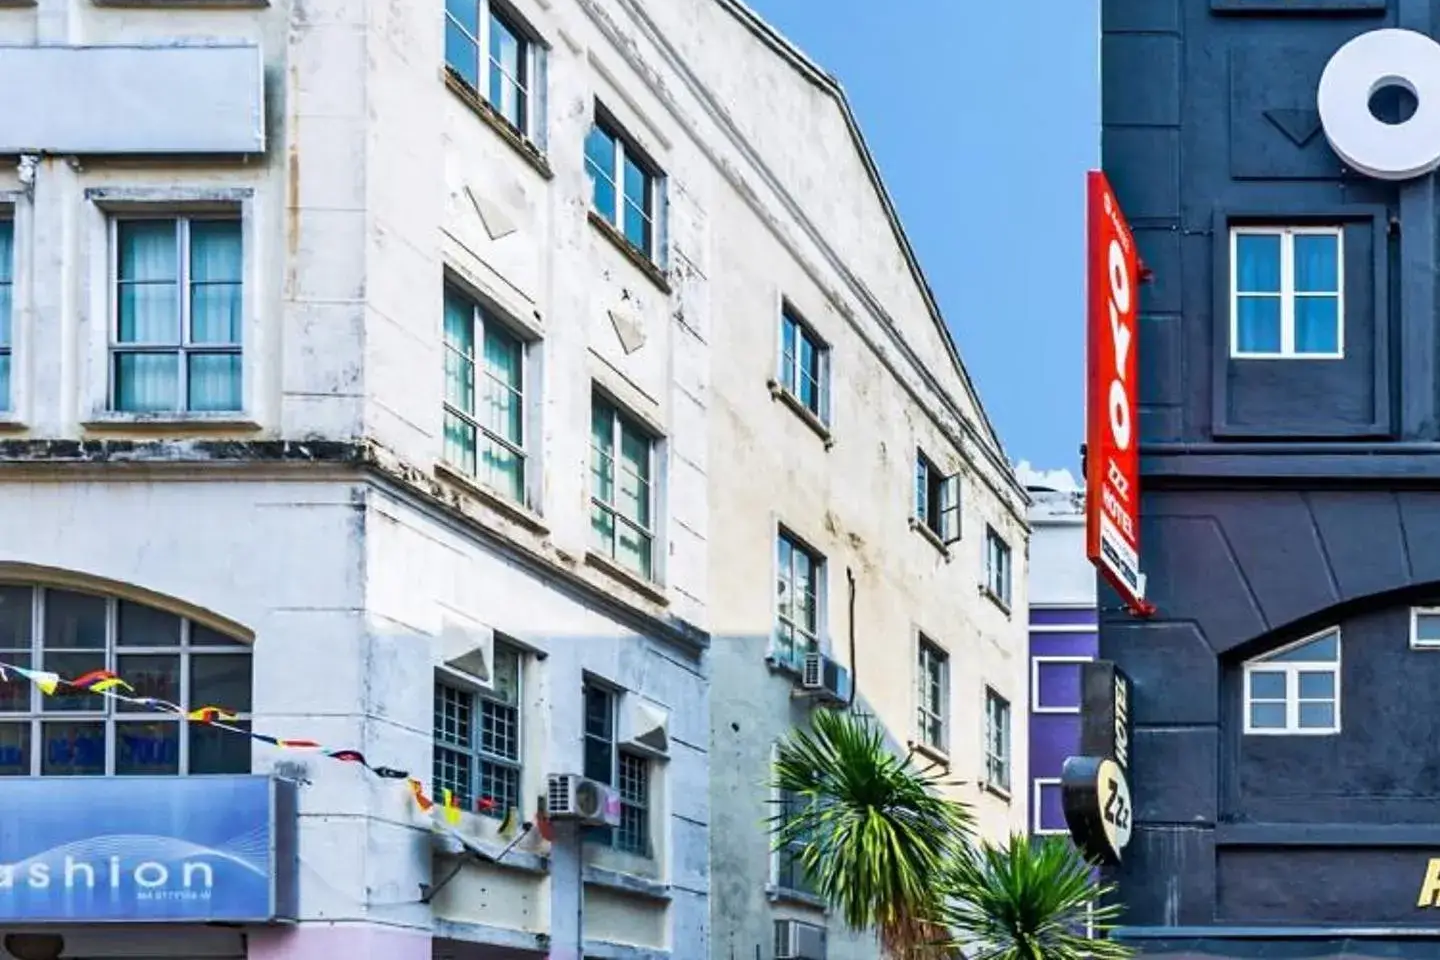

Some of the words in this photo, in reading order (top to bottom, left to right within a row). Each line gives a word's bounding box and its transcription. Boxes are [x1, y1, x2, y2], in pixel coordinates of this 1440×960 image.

[1109, 239, 1131, 451] OYO
[1102, 482, 1135, 542] HOTEL
[1114, 674, 1128, 769] HOTEL
